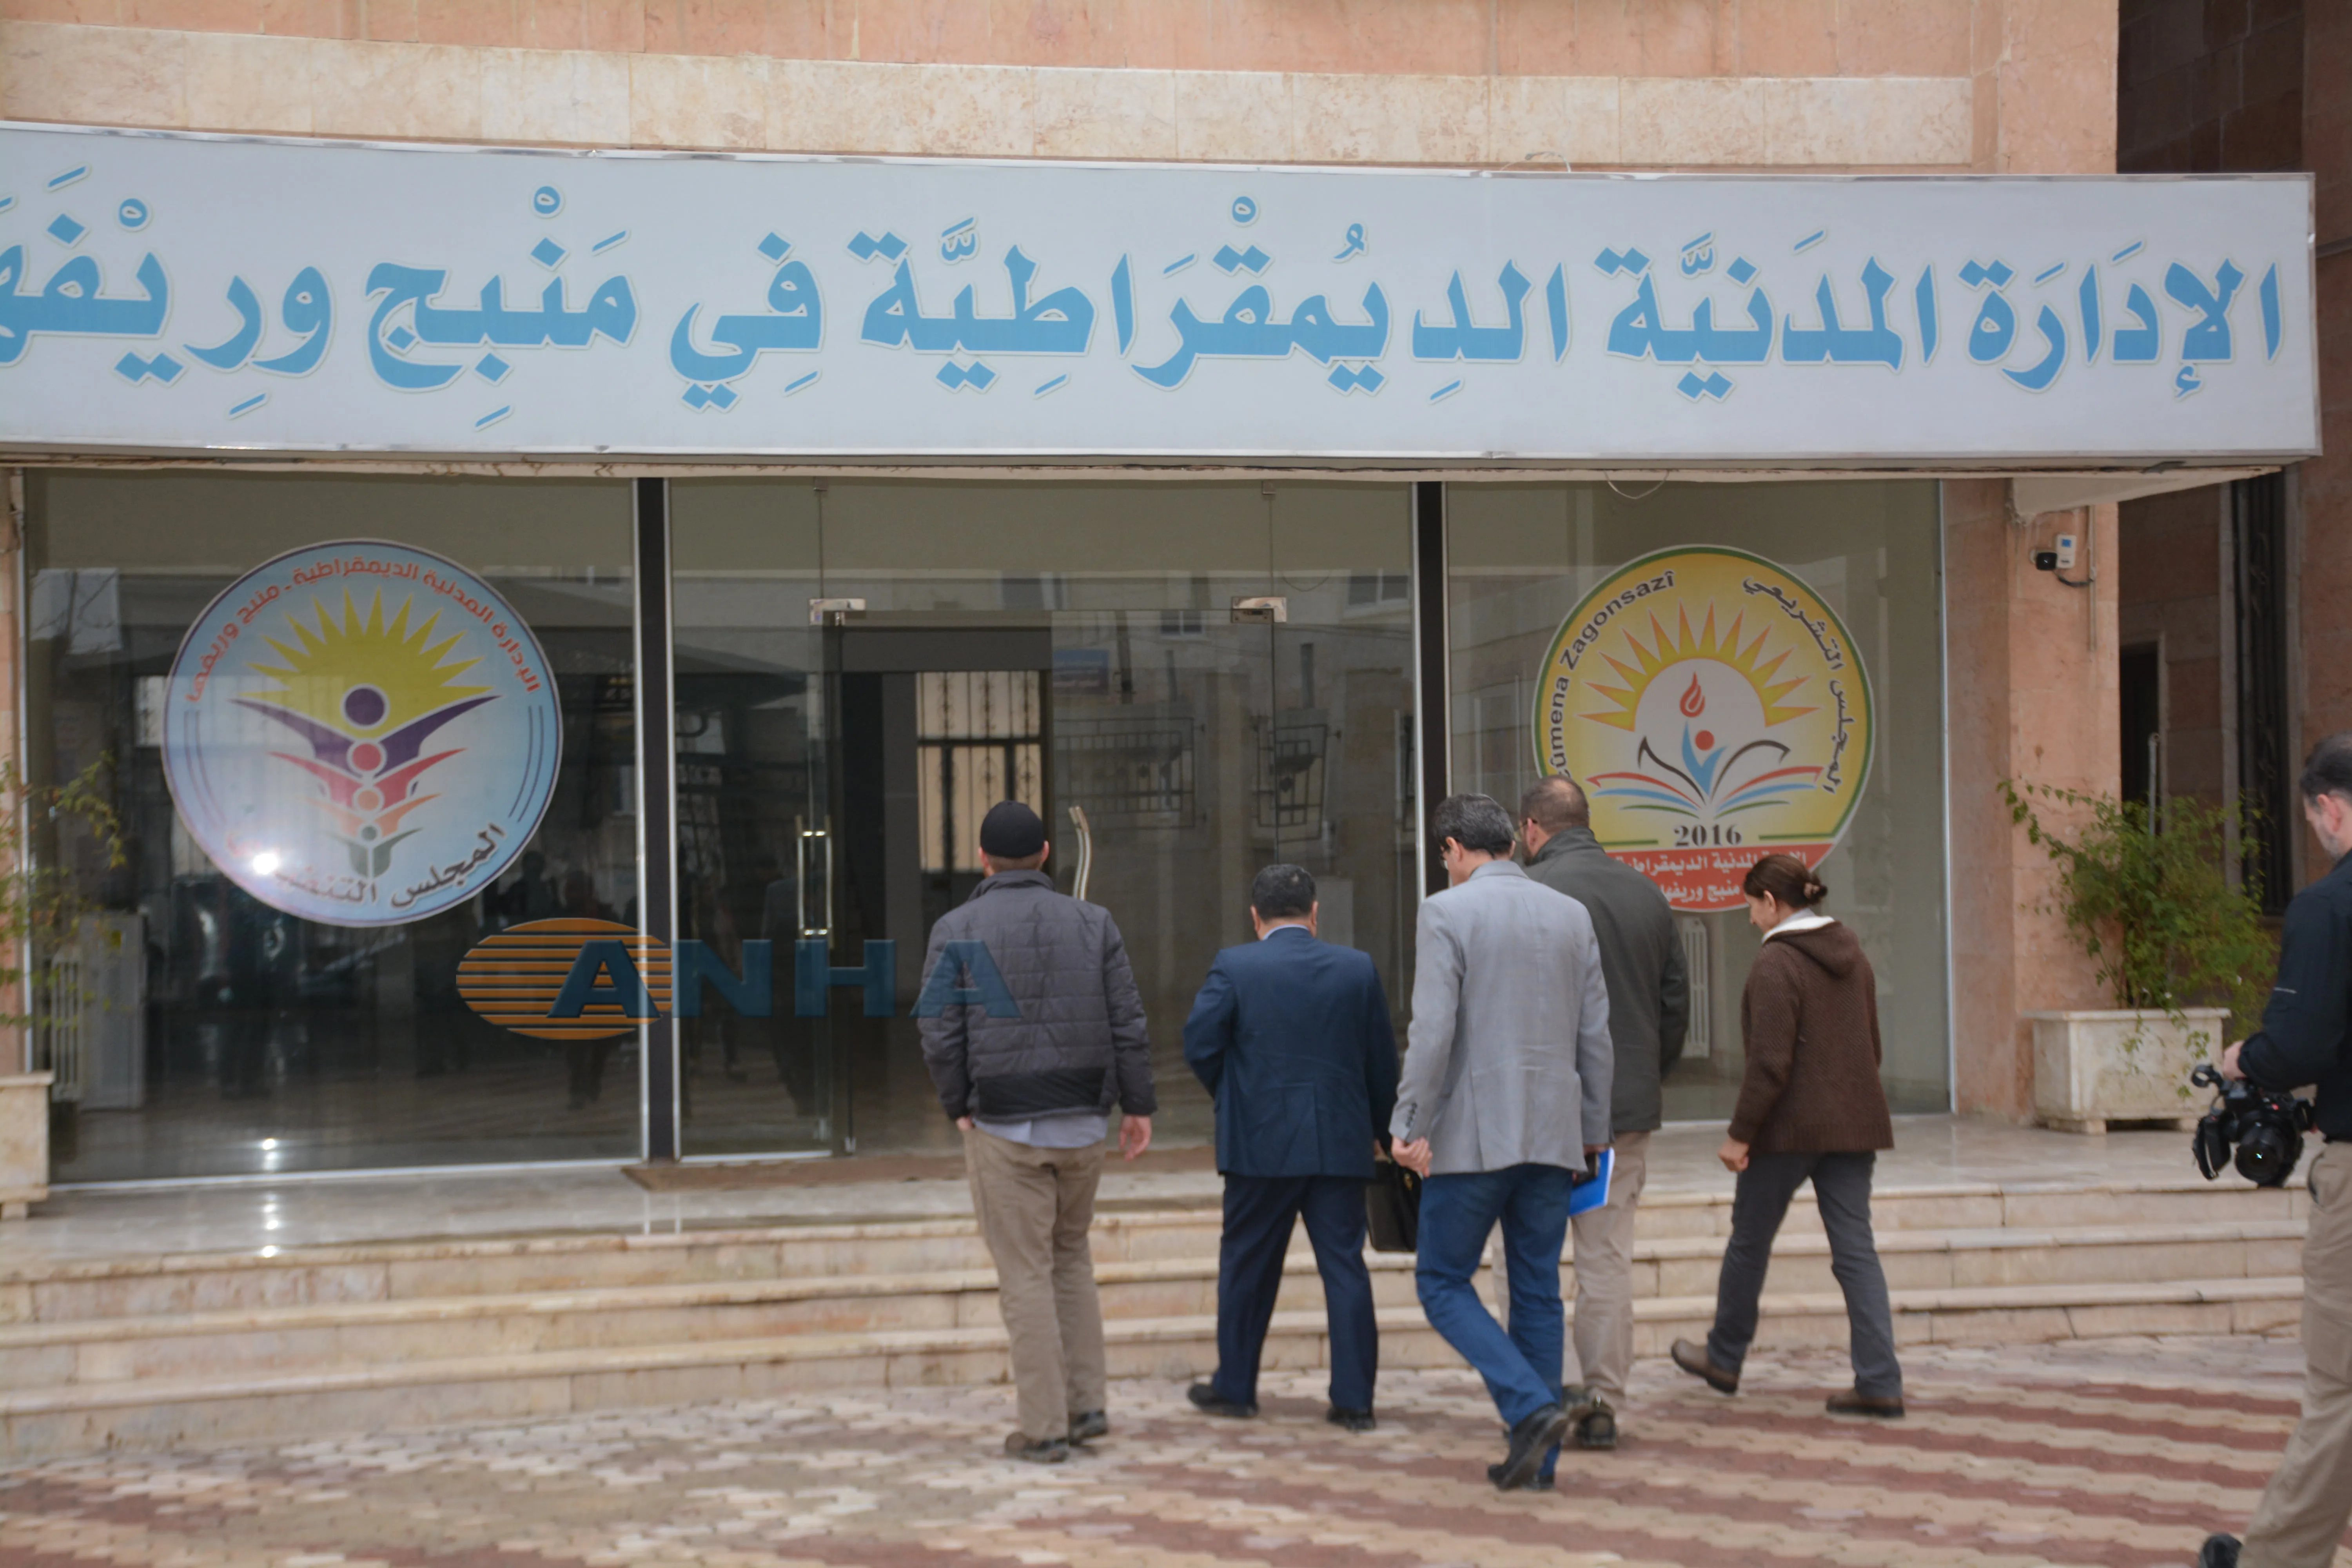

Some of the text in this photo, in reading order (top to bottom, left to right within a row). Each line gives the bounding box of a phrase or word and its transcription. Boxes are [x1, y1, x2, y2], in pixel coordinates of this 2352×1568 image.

[293, 556, 419, 584] الديمقراطية
[237, 585, 279, 624] منبج
[423, 570, 494, 623] المدنية
[1560, 571, 1674, 670] Zagonsazî
[185, 623, 239, 702] وريفها
[1743, 578, 1854, 793] المجلس التشريعي
[1674, 825, 1742, 846] 2016
[392, 824, 504, 907] المجلس
[1615, 854, 1708, 876] الديمقراط
[1708, 879, 1740, 902] منبج
